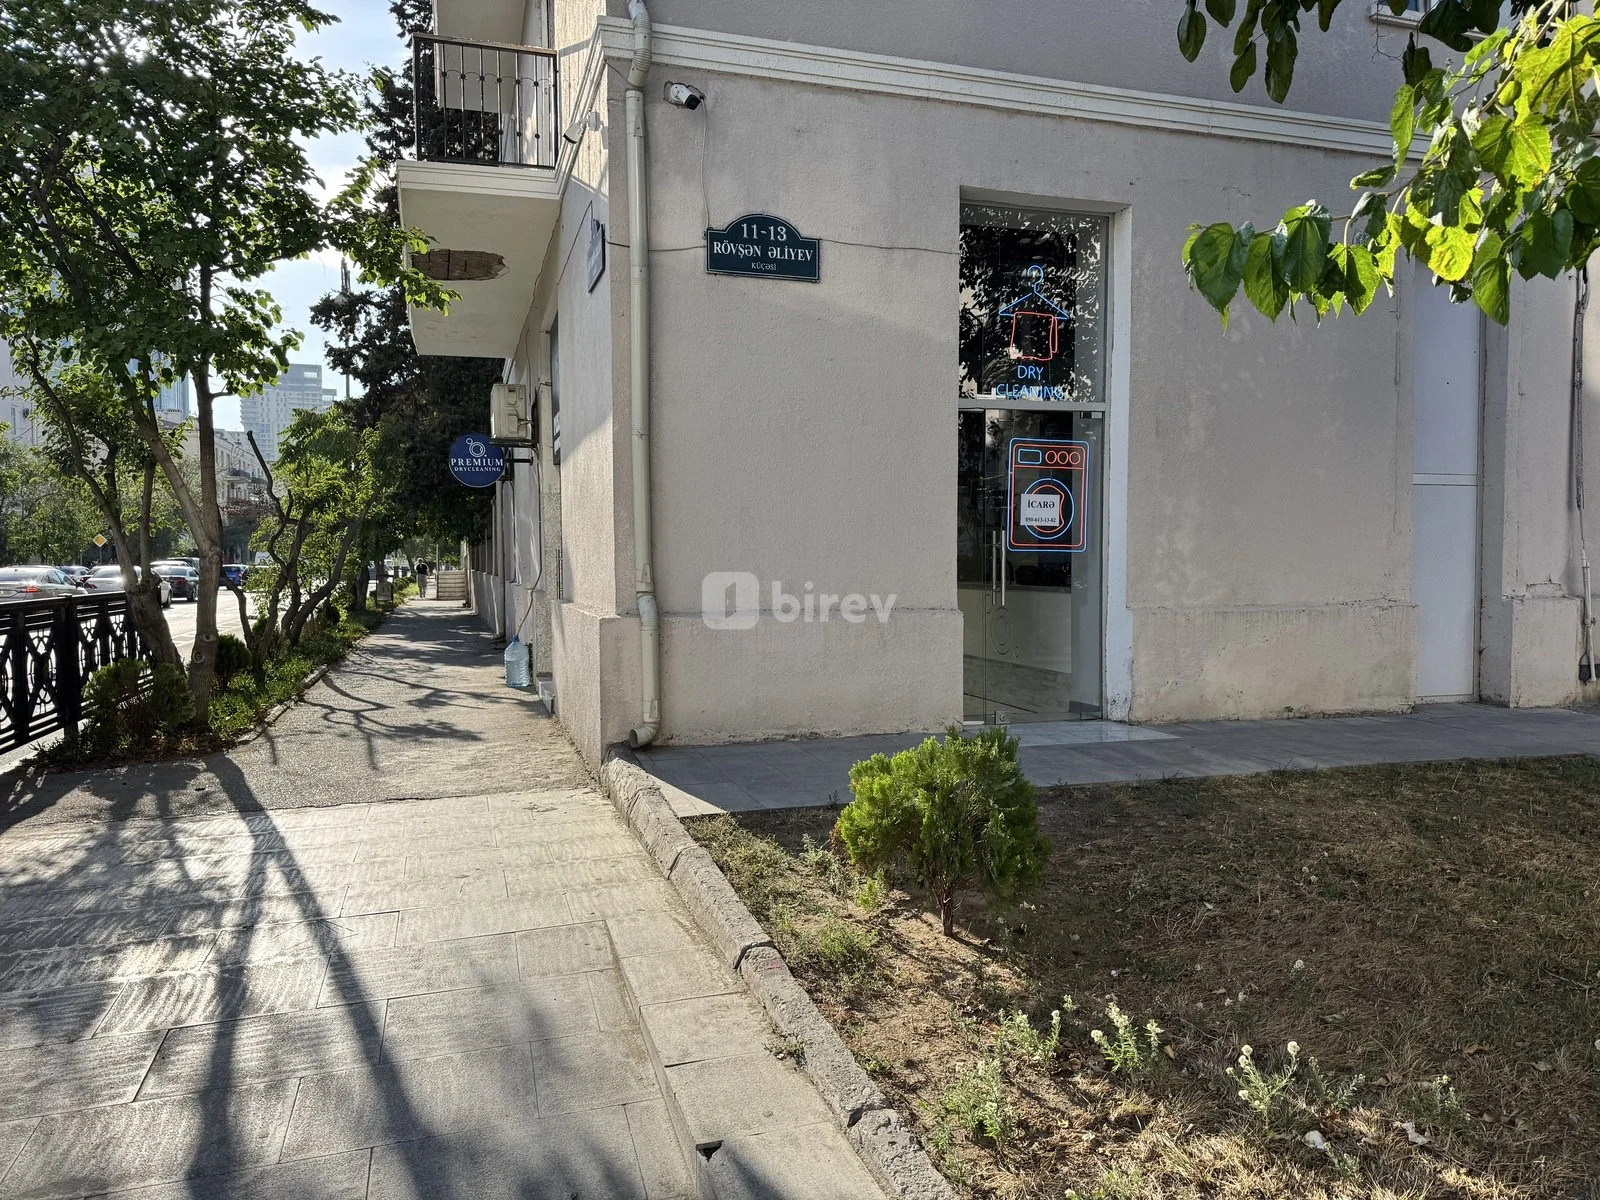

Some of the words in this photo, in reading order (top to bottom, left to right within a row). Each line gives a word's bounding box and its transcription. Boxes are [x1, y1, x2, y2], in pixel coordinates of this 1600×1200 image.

[741, 223, 787, 241] 11-13
[713, 240, 761, 258] RÖVŞƏN
[768, 245, 813, 261] ƏLİYEV
[1017, 365, 1044, 380] DRY
[996, 383, 1064, 399] CLEANING
[451, 458, 503, 466] PREMIUM
[1027, 499, 1055, 508] İCARƏ
